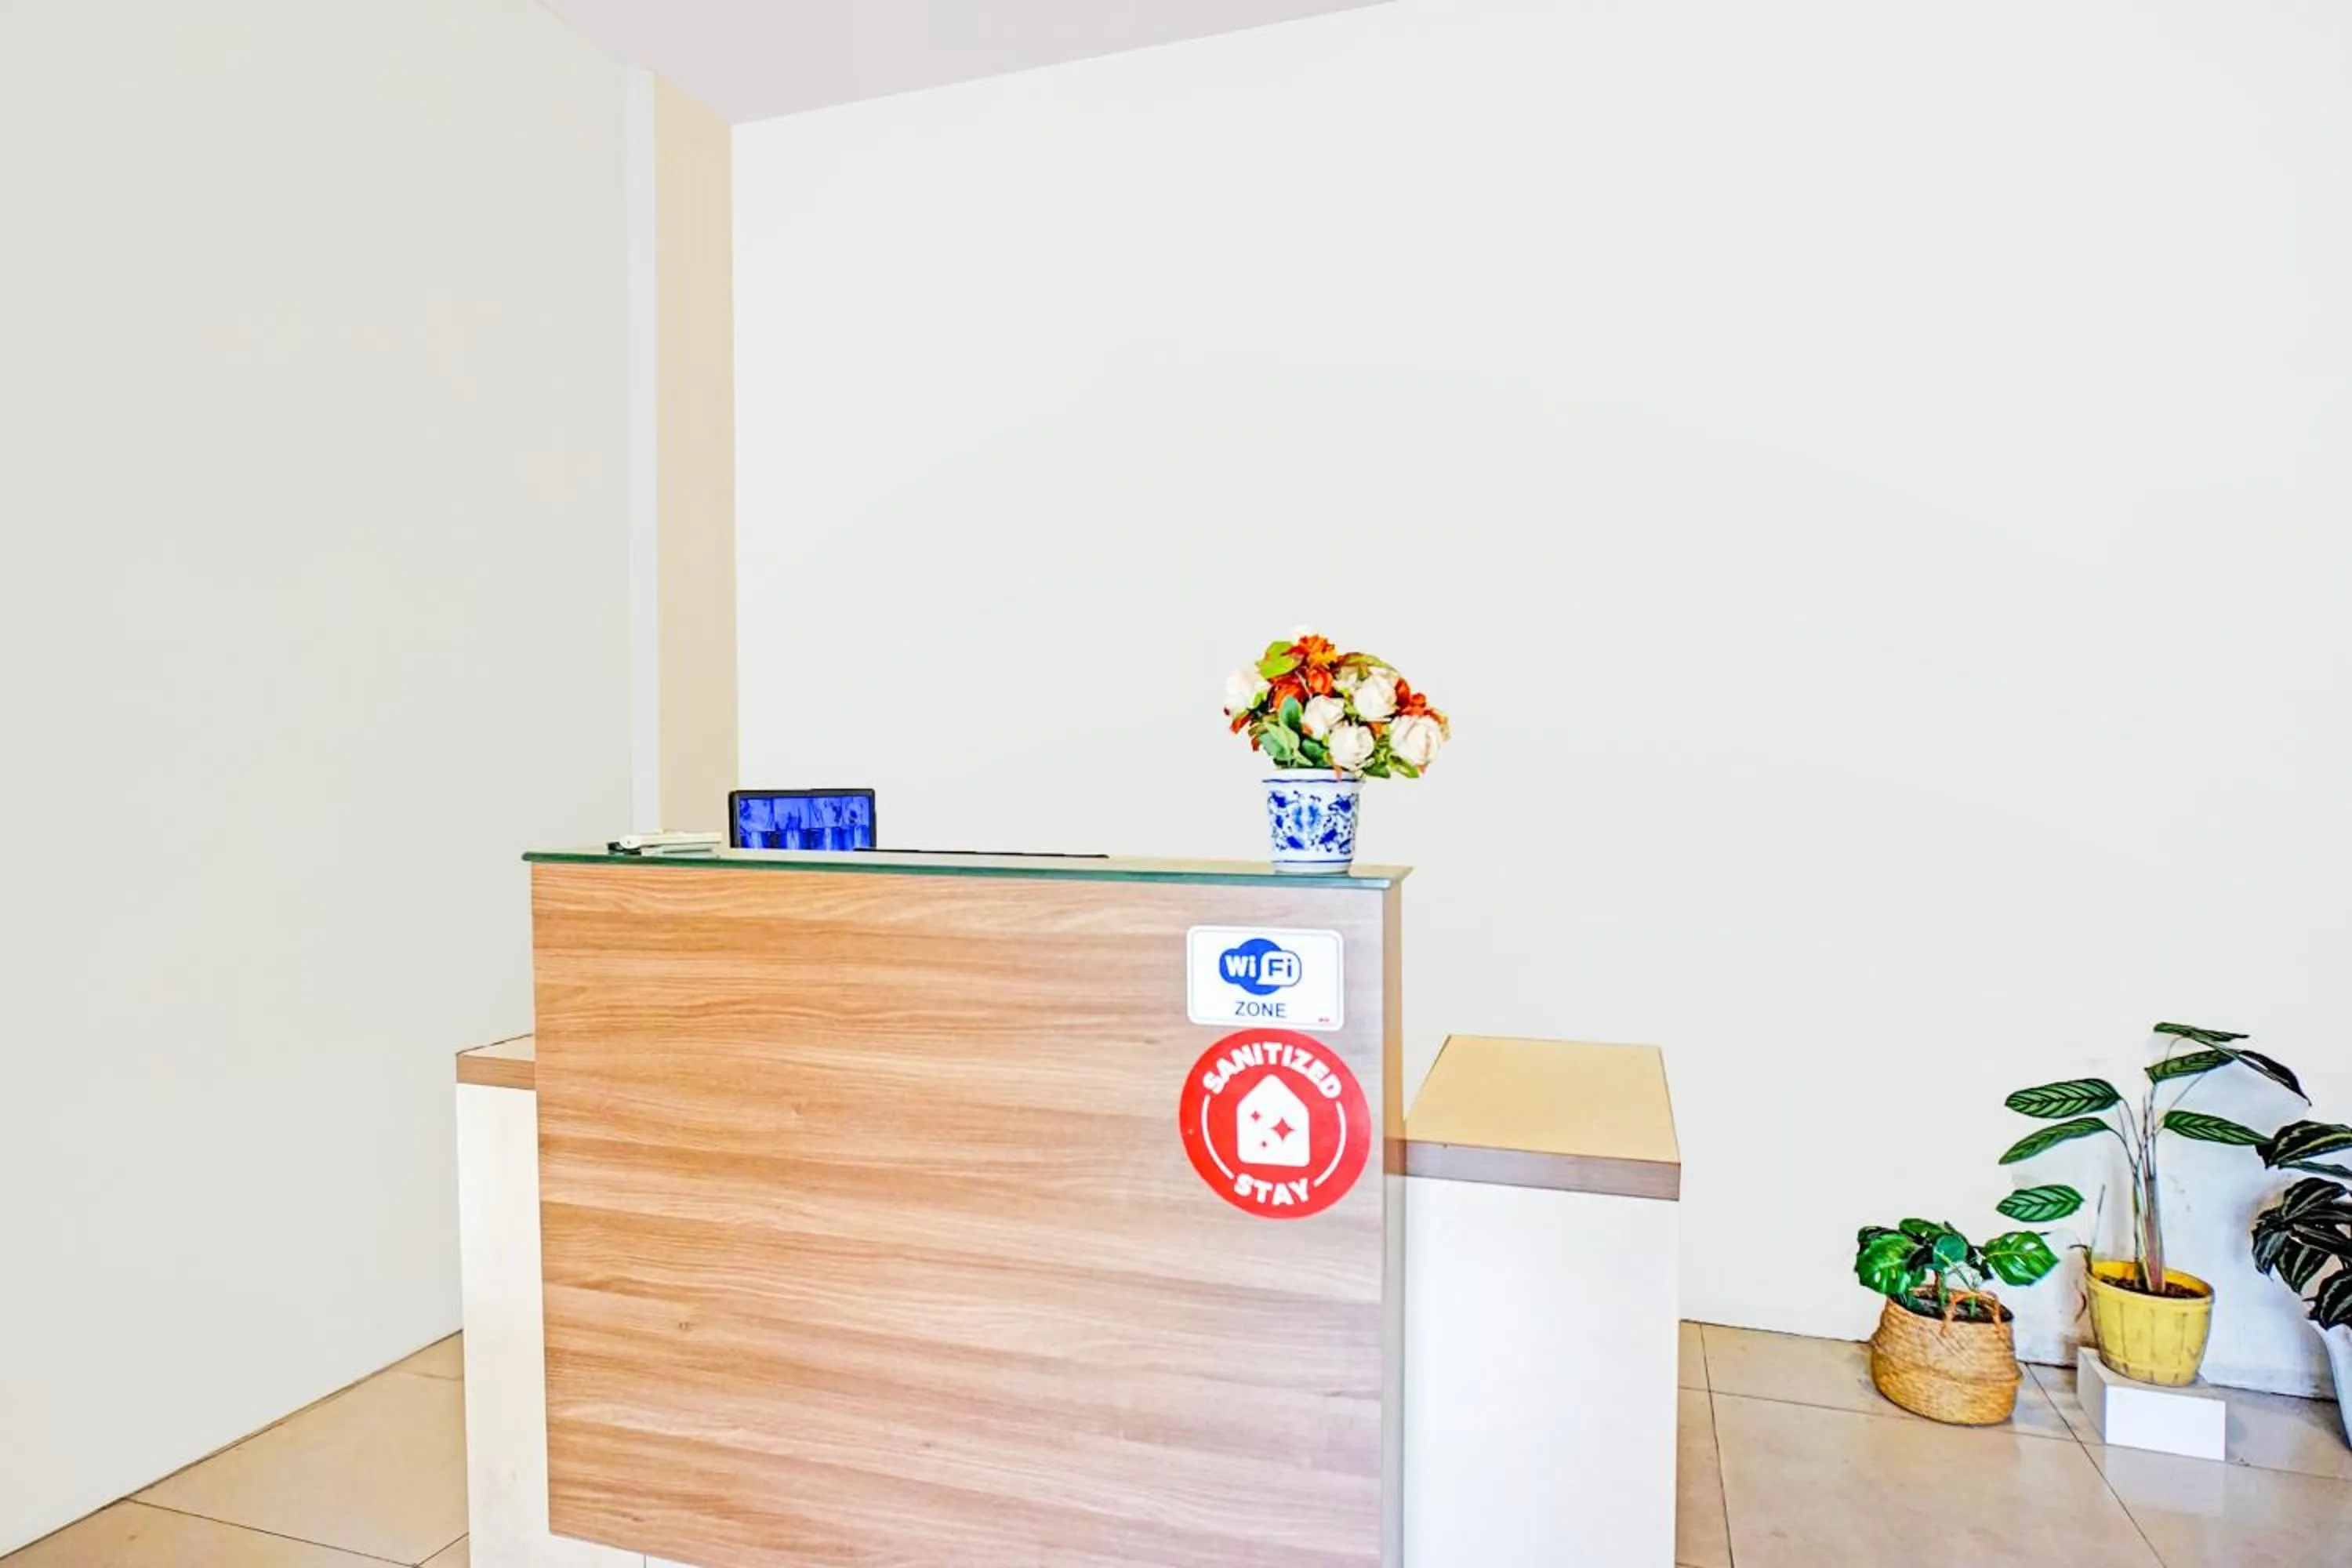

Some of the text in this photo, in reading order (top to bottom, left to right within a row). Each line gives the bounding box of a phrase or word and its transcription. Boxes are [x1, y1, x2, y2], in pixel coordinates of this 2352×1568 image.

[1235, 1001, 1287, 1018] ZONE
[1203, 1042, 1342, 1098] SANITIZED
[1234, 1173, 1308, 1206] STAY
